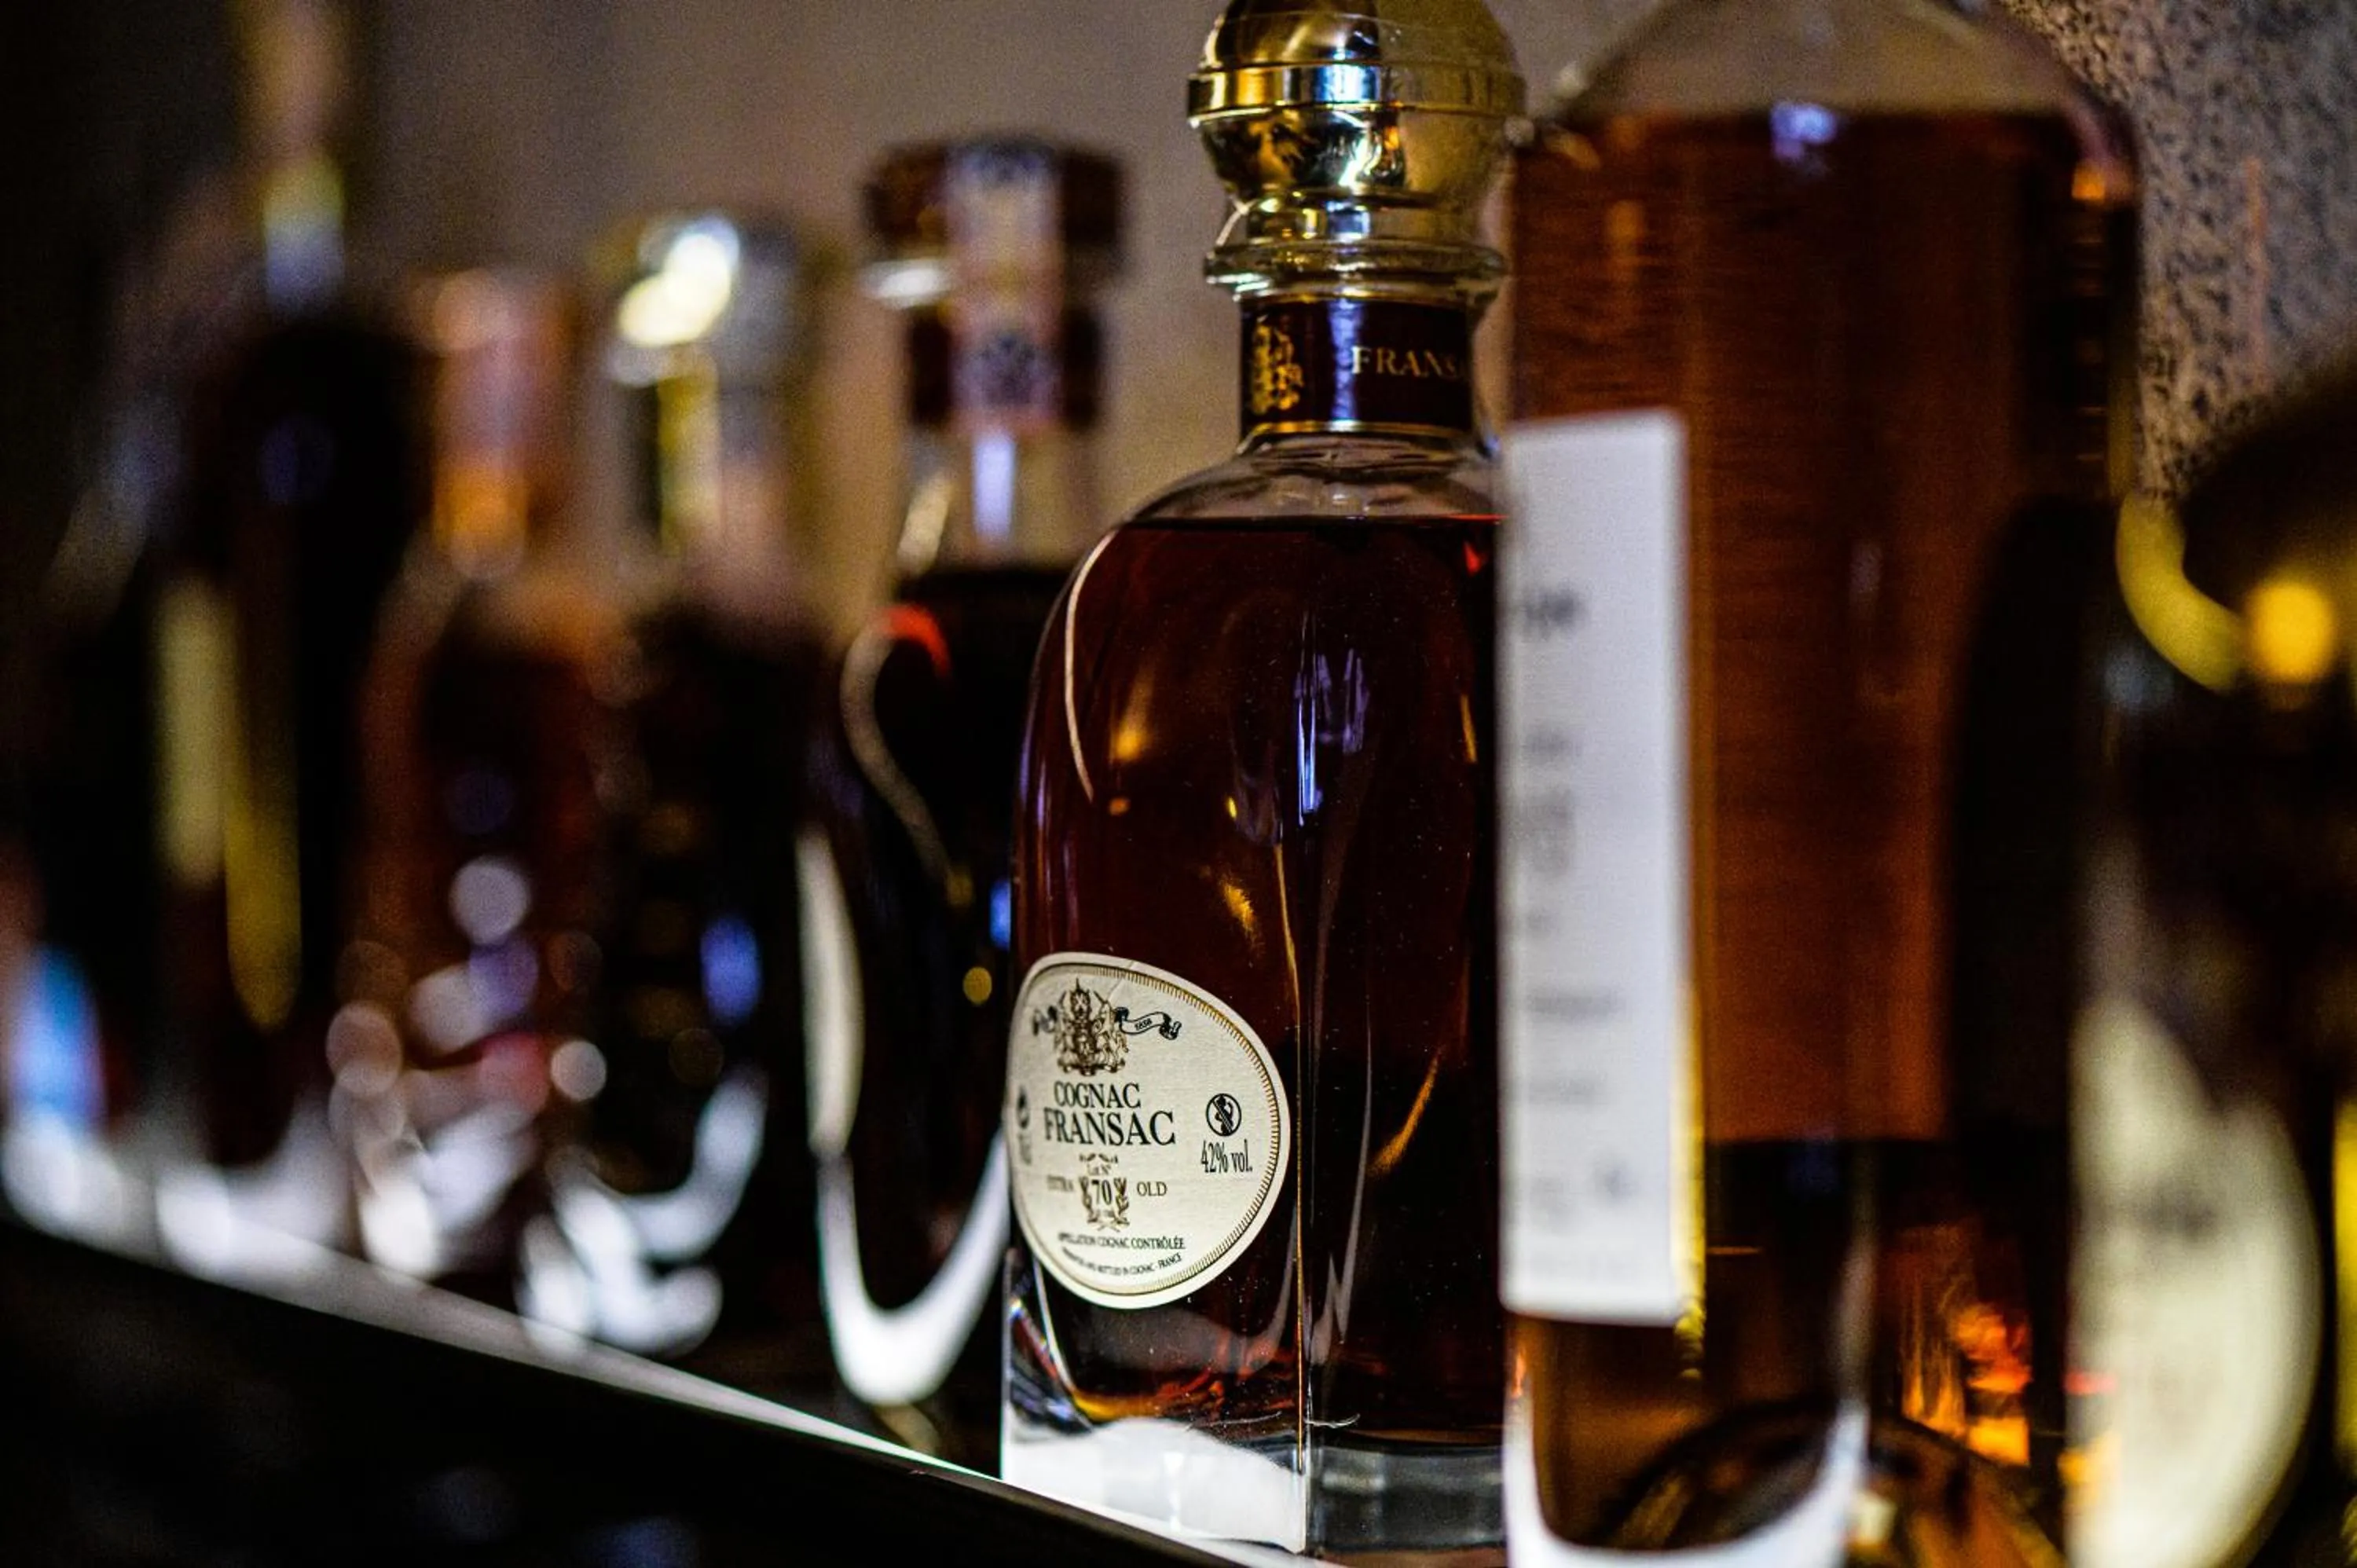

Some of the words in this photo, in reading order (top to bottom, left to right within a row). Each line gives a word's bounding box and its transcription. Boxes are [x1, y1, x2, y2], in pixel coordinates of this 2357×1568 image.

[1054, 1081, 1142, 1108] COGNAC
[1043, 1107, 1176, 1146] FRANSAC
[1200, 1140, 1229, 1174] 42%
[1230, 1138, 1253, 1173] vol.
[1091, 1179, 1113, 1205] 70
[1137, 1181, 1168, 1196] OLD
[1131, 1235, 1186, 1249] CONTRÔLÉE
